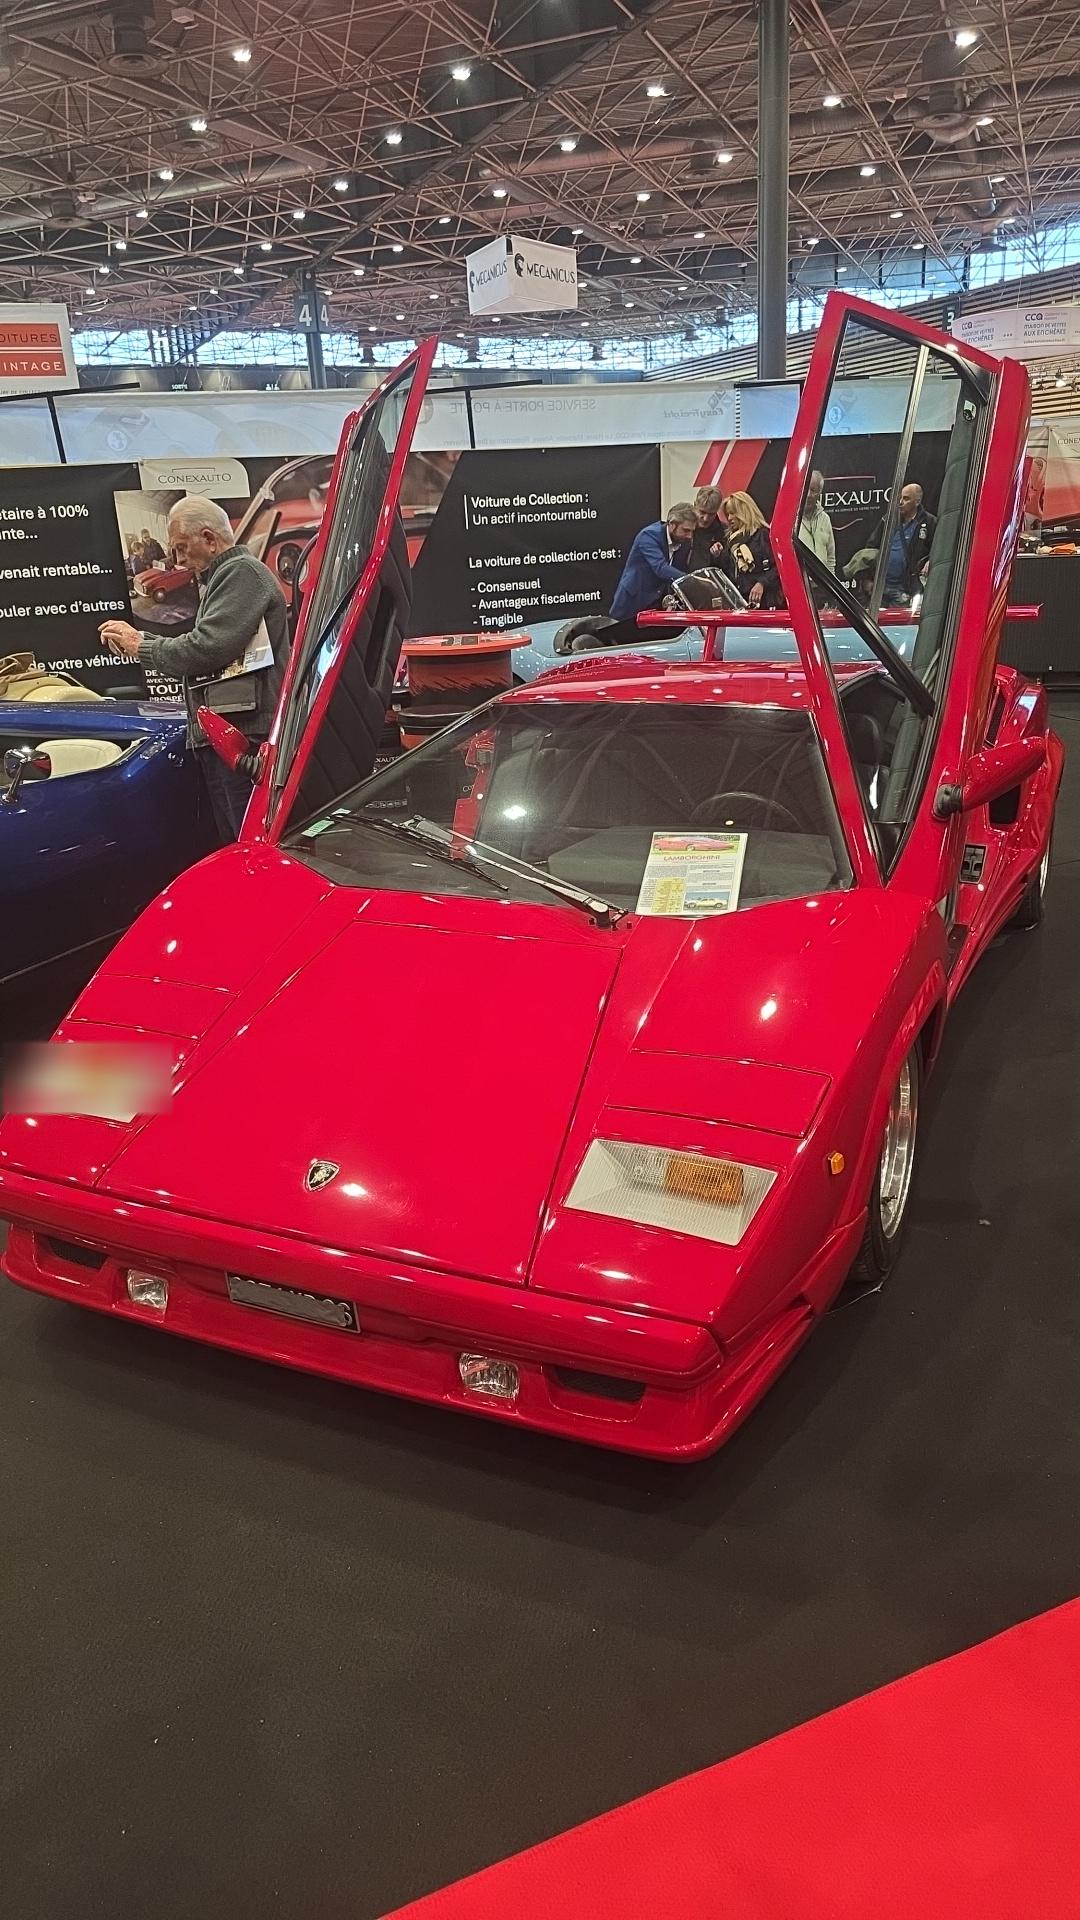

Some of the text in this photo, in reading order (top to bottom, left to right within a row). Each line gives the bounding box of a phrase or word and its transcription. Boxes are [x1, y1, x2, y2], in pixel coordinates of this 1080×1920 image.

[475, 259, 508, 286] MECANICUS
[526, 262, 576, 284] MECANICUS
[298, 304, 312, 327] 4
[320, 304, 329, 327] 4
[3, 361, 63, 371] INTAGE
[158, 473, 231, 484] CONEXAUTO
[471, 496, 510, 508] Voiture
[512, 494, 526, 506] de
[528, 492, 583, 505] Collection
[0, 504, 89, 520] taire à 100%
[472, 508, 597, 525] Un actif incontournable
[469, 557, 482, 568] La
[484, 554, 521, 567] voiture
[523, 553, 537, 564] de
[538, 549, 590, 563] collection
[591, 548, 617, 560] c'est
[43, 561, 113, 576] rentable...
[477, 578, 541, 593] Consensuel
[478, 597, 539, 610] Avantageux
[541, 590, 601, 604] fiscalement
[34, 604, 67, 616] avec
[479, 613, 524, 628] Tangible
[47, 658, 83, 671] votre
